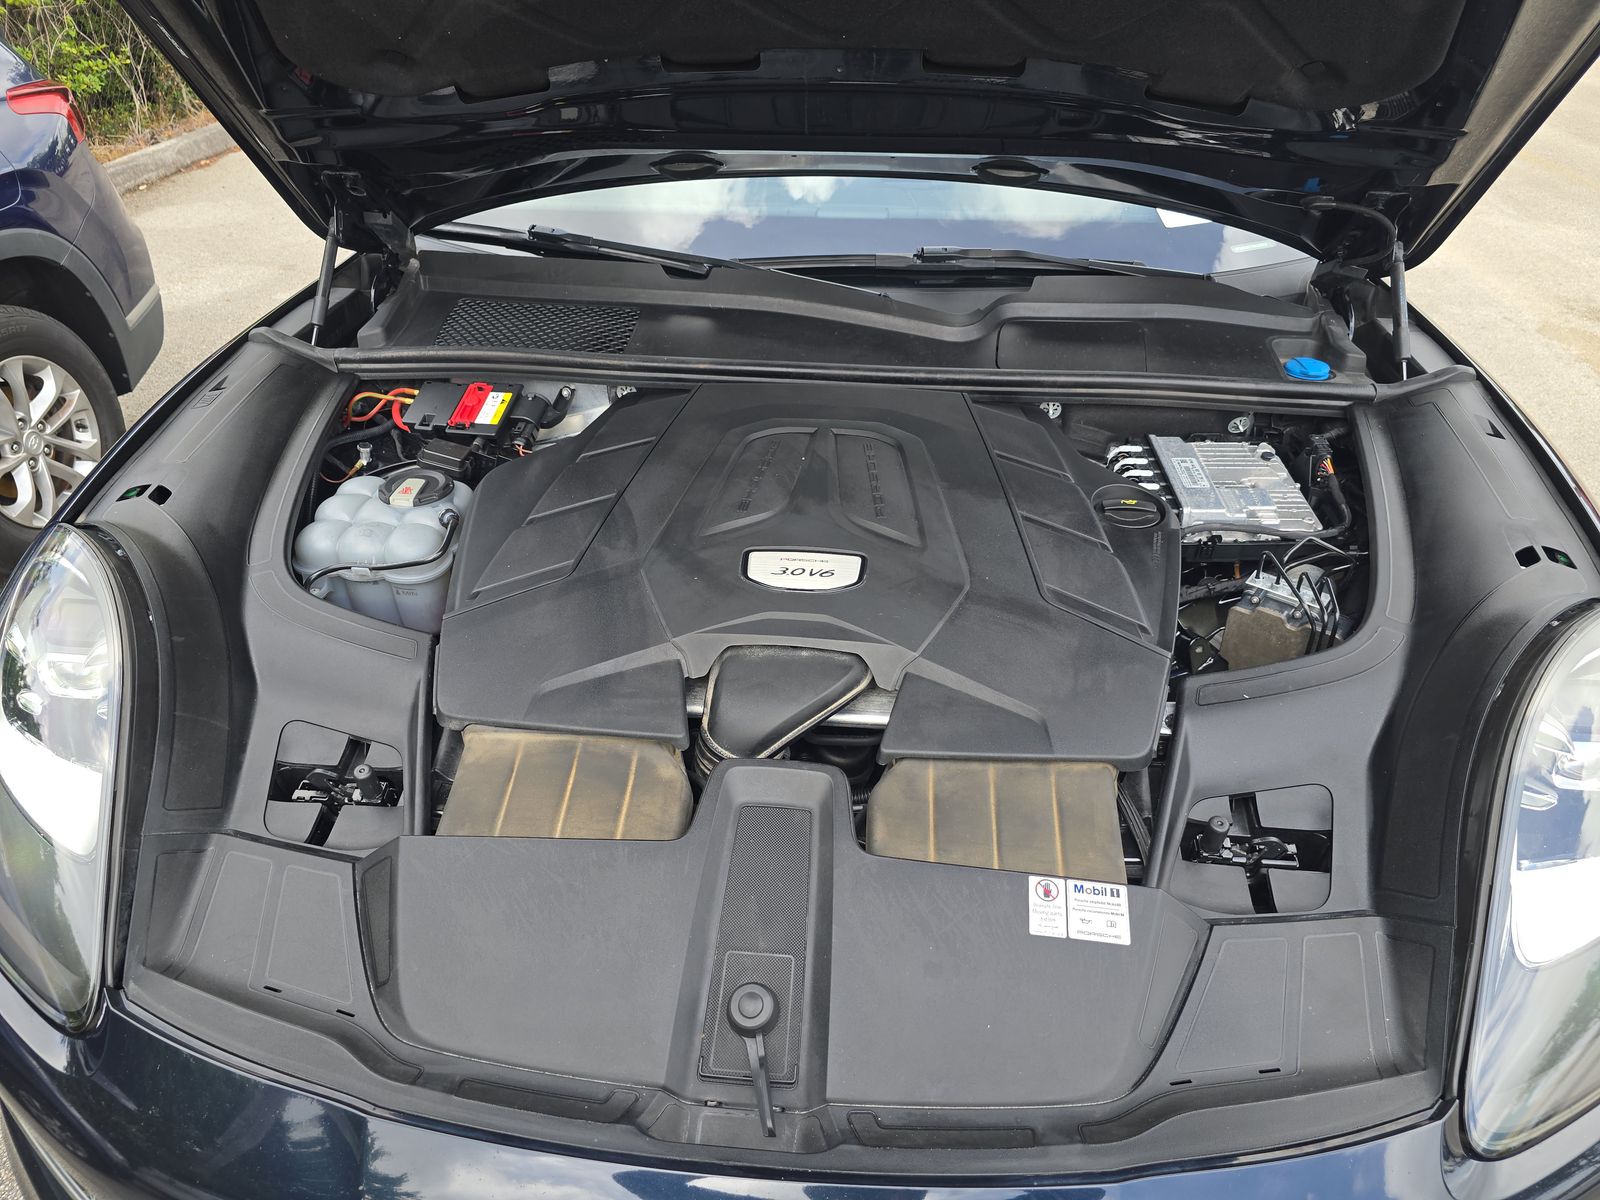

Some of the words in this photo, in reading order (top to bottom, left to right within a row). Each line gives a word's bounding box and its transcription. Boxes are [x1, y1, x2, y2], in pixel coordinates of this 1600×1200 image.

[863, 441, 888, 519] PORSCHE
[1073, 883, 1107, 897] Mobil
[1109, 887, 1121, 898] 1
